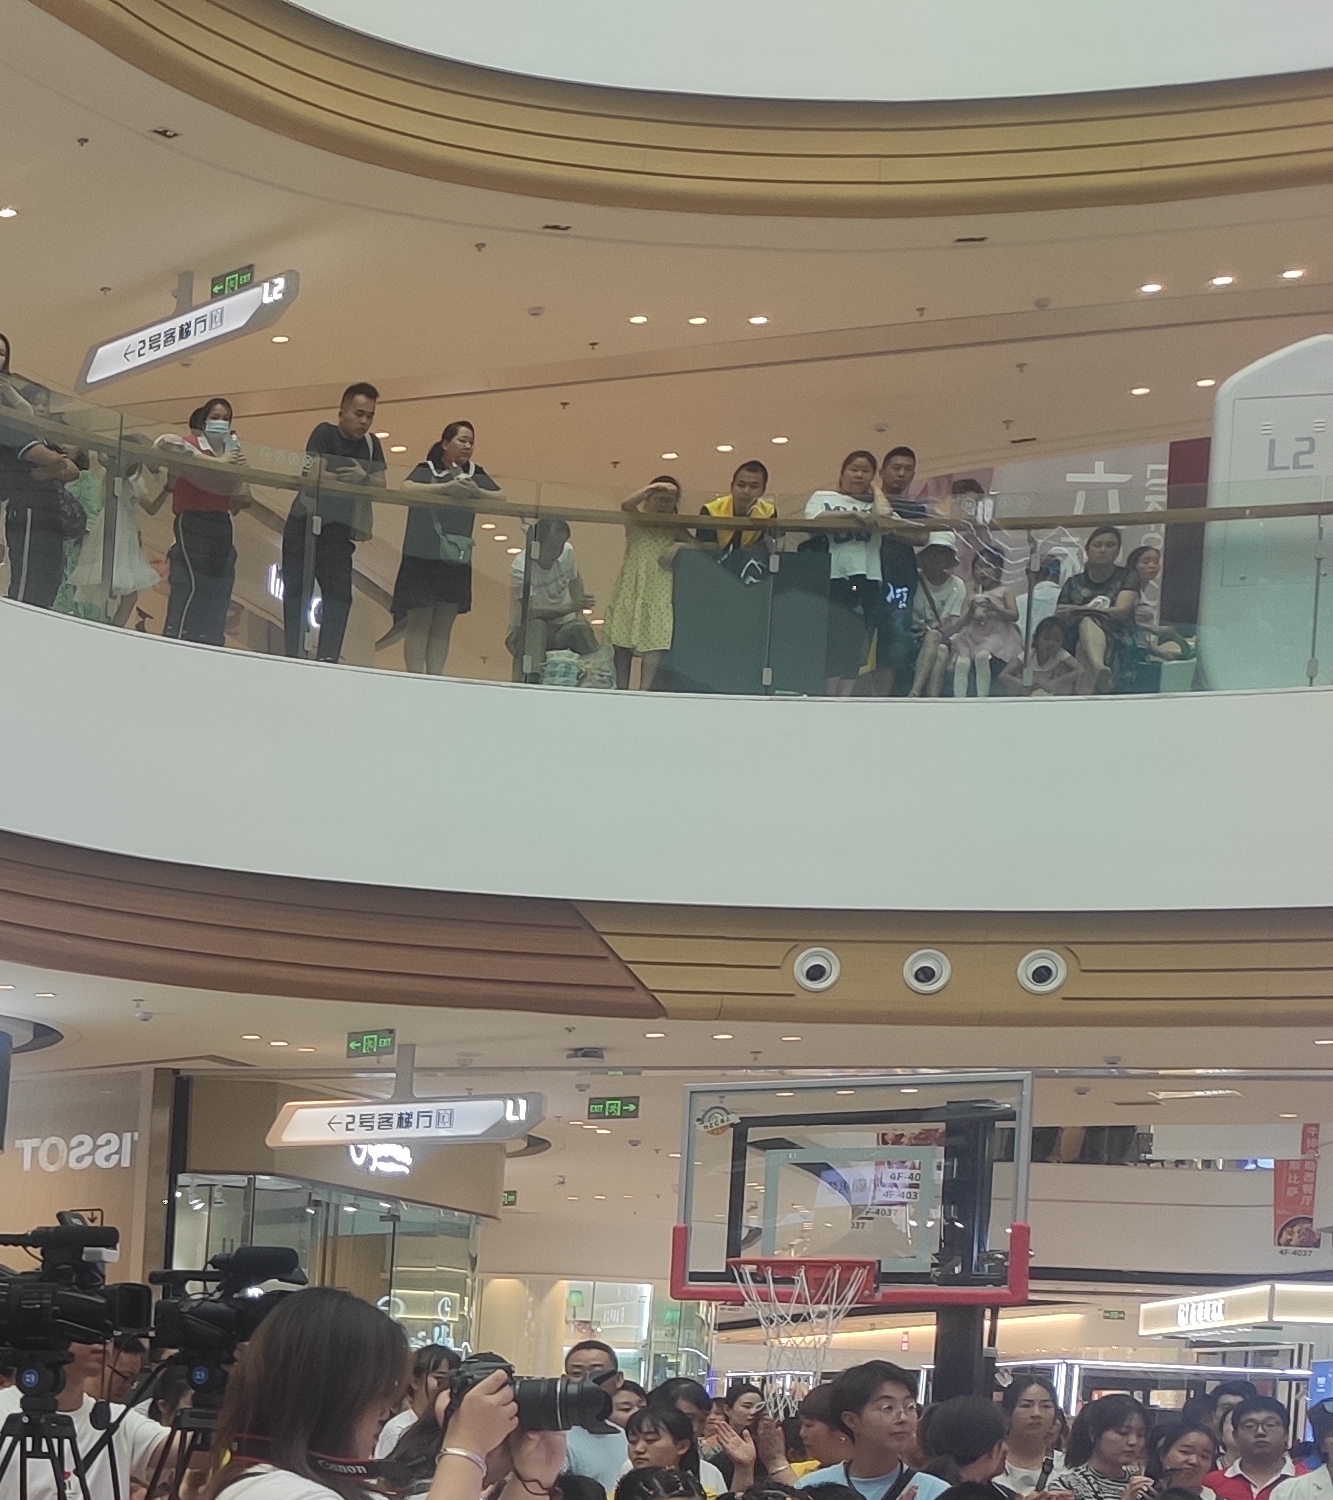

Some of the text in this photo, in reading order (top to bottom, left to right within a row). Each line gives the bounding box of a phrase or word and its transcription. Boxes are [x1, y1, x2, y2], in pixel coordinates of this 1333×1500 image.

[262, 276, 285, 304] L2
[137, 313, 208, 358] 2号客梯厅
[1268, 436, 1315, 471] L2
[345, 1110, 434, 1132] 2号客梯厅
[317, 1459, 368, 1475] Canon
